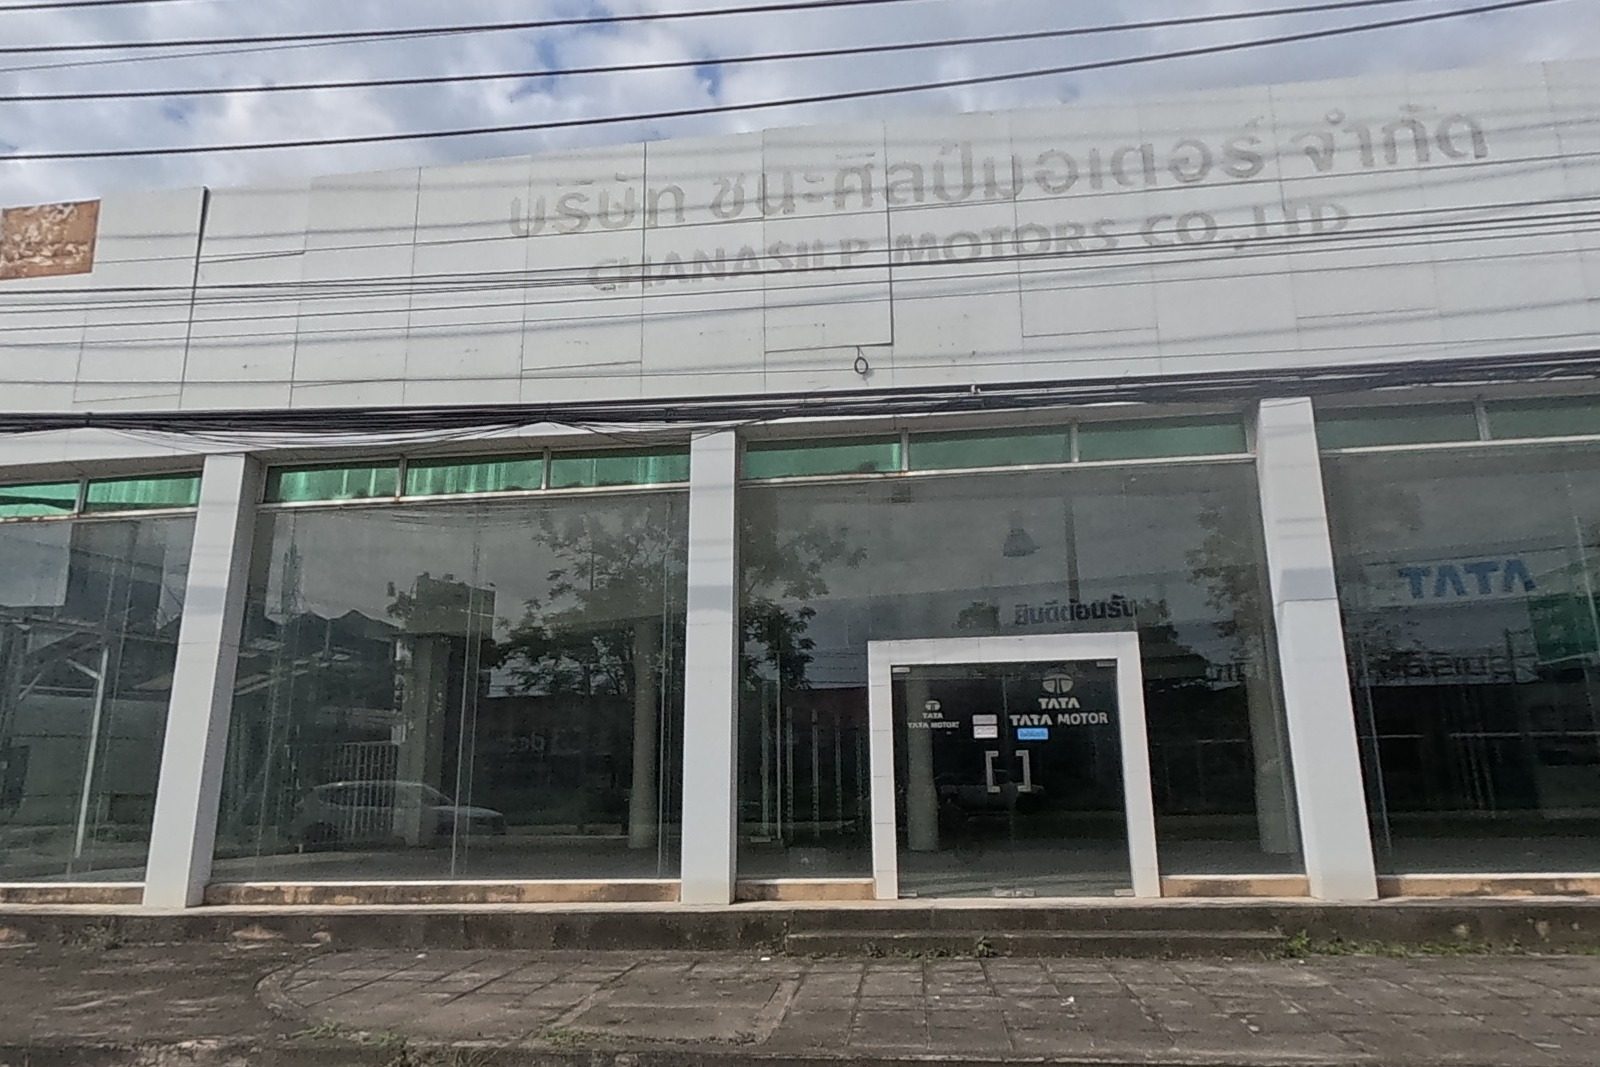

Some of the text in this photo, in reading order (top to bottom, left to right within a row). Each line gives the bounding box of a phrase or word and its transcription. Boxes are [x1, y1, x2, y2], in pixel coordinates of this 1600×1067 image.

[1301, 103, 1489, 173] จำกัด
[894, 217, 1119, 264] MOTORS
[1397, 559, 1537, 600] TATA
[921, 712, 944, 720] TATA
[1037, 696, 1081, 710] TATA
[1008, 711, 1109, 727] TATA MOTOR
